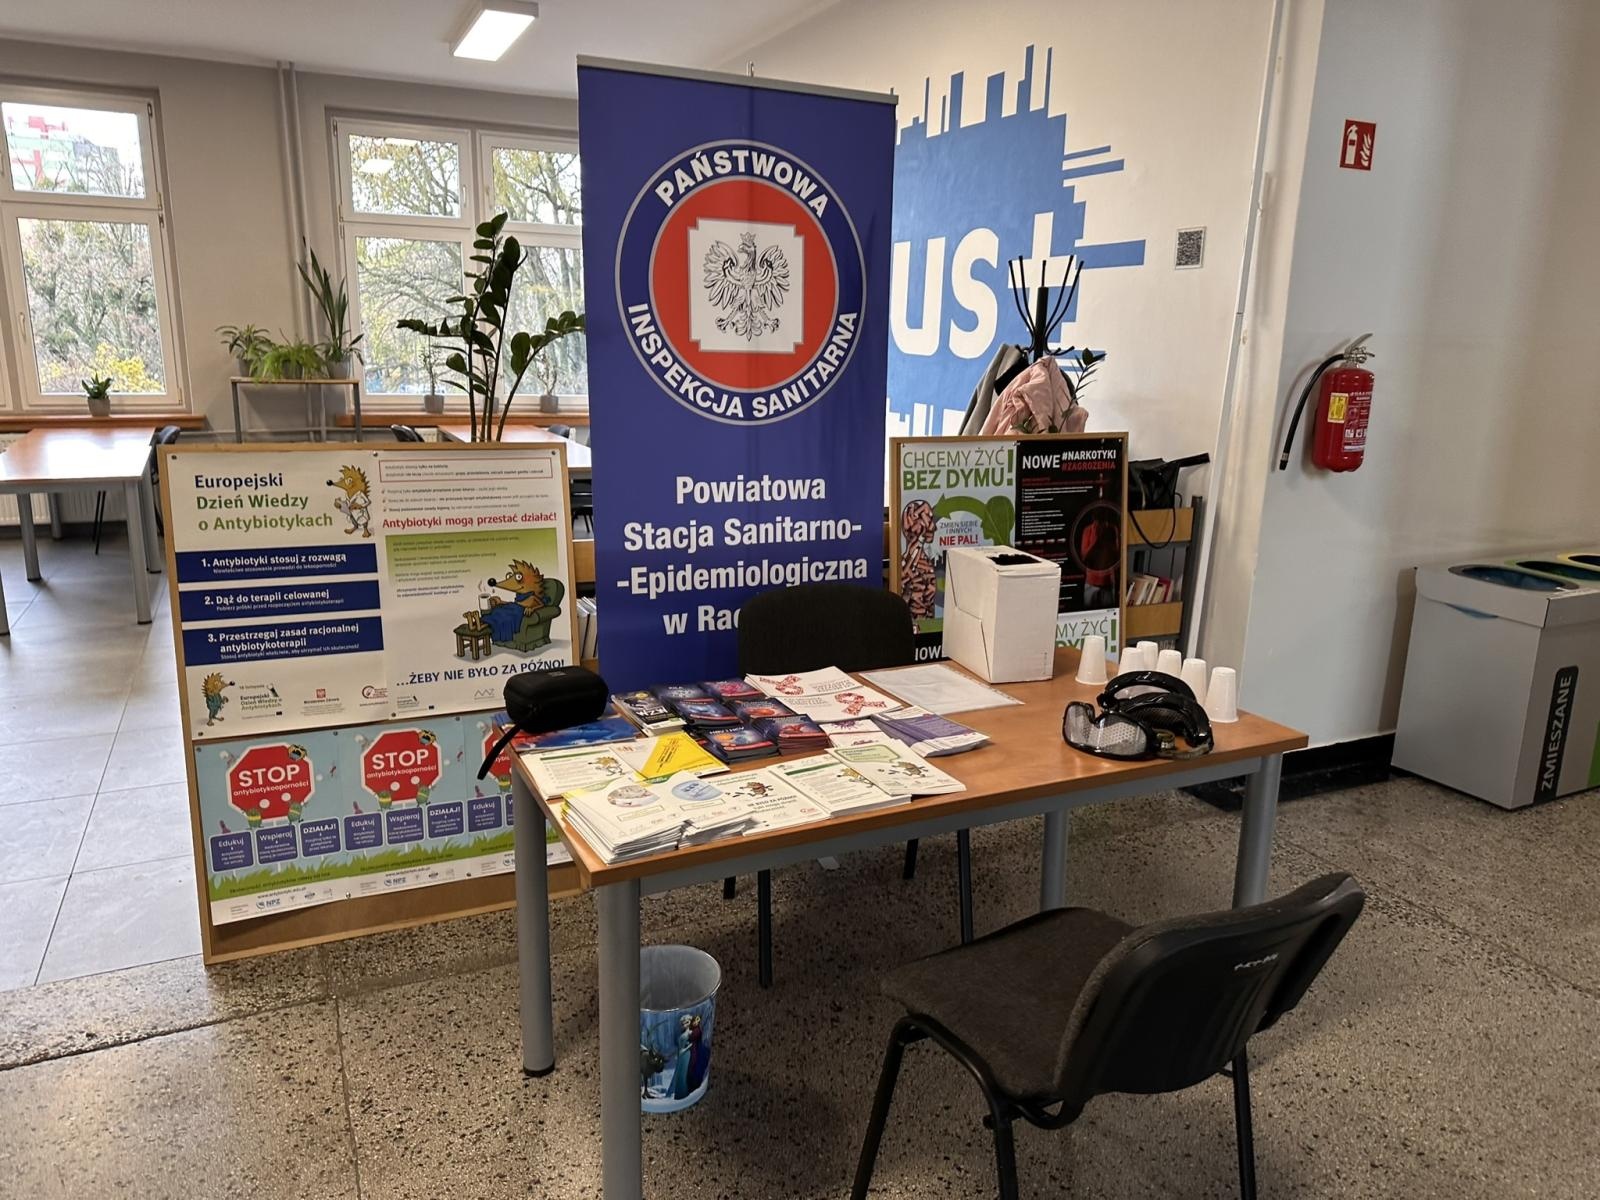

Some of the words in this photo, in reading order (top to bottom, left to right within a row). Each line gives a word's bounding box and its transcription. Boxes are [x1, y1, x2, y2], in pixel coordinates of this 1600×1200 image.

[655, 149, 829, 218] PAŃSTWOWA
[628, 303, 744, 418] INSPEKCJA
[752, 312, 858, 418] SANITARNA
[903, 450, 972, 469] CHCEMY
[974, 446, 1005, 467] ŻYĆ
[1022, 455, 1060, 470] NOWE
[1062, 450, 1117, 461] #NARKOTYKI
[1062, 460, 1116, 472] #ZAGROŻENIA
[194, 473, 283, 491] Europejski
[676, 474, 826, 504] Powiatowa
[903, 469, 942, 491] BEZ
[197, 495, 244, 510] Dzień
[248, 494, 309, 511] Wiedzy
[198, 520, 209, 531] o
[213, 513, 333, 533] Antybiotykach
[382, 517, 442, 530] Antybiotyki
[445, 517, 474, 528] mogą
[477, 514, 518, 527] przestać
[521, 512, 557, 523] działać!
[623, 520, 714, 553] Stacja
[724, 516, 862, 546] Sanitarno-
[939, 535, 956, 546] NIE
[958, 534, 978, 545] PAL!
[201, 558, 211, 568] 1.
[212, 556, 268, 568] Antybiotyki
[270, 554, 299, 565] stosuj
[301, 555, 306, 563] z
[308, 553, 347, 564] rozwagą
[617, 556, 868, 600] -Epidemiologiczna
[204, 596, 214, 606] 2.
[216, 595, 235, 606] Dąż
[236, 594, 249, 604] do
[250, 592, 281, 603] terapii
[283, 589, 330, 601] celowanej
[207, 633, 217, 643] 3.
[219, 629, 278, 642] Przestrzegaj
[280, 627, 307, 638] zasad
[309, 623, 359, 636] racjonalnej
[662, 613, 688, 635] w
[1081, 616, 1108, 637] ŻYĆ
[220, 638, 307, 654] antybiotykoterapii
[444, 669, 464, 681] NIE
[468, 665, 498, 678] BYŁO
[502, 663, 517, 675] ZA
[521, 658, 565, 673] PÓŹNO!
[1541, 675, 1572, 792] ZMIESZANE
[372, 749, 429, 770] STOP
[239, 764, 300, 787] STOP
[473, 801, 495, 811] Edukuj
[351, 818, 375, 828] Edukuj
[389, 811, 420, 822] Wspieraj
[218, 837, 244, 848] Edukuj
[259, 831, 293, 841] Wspieraj
